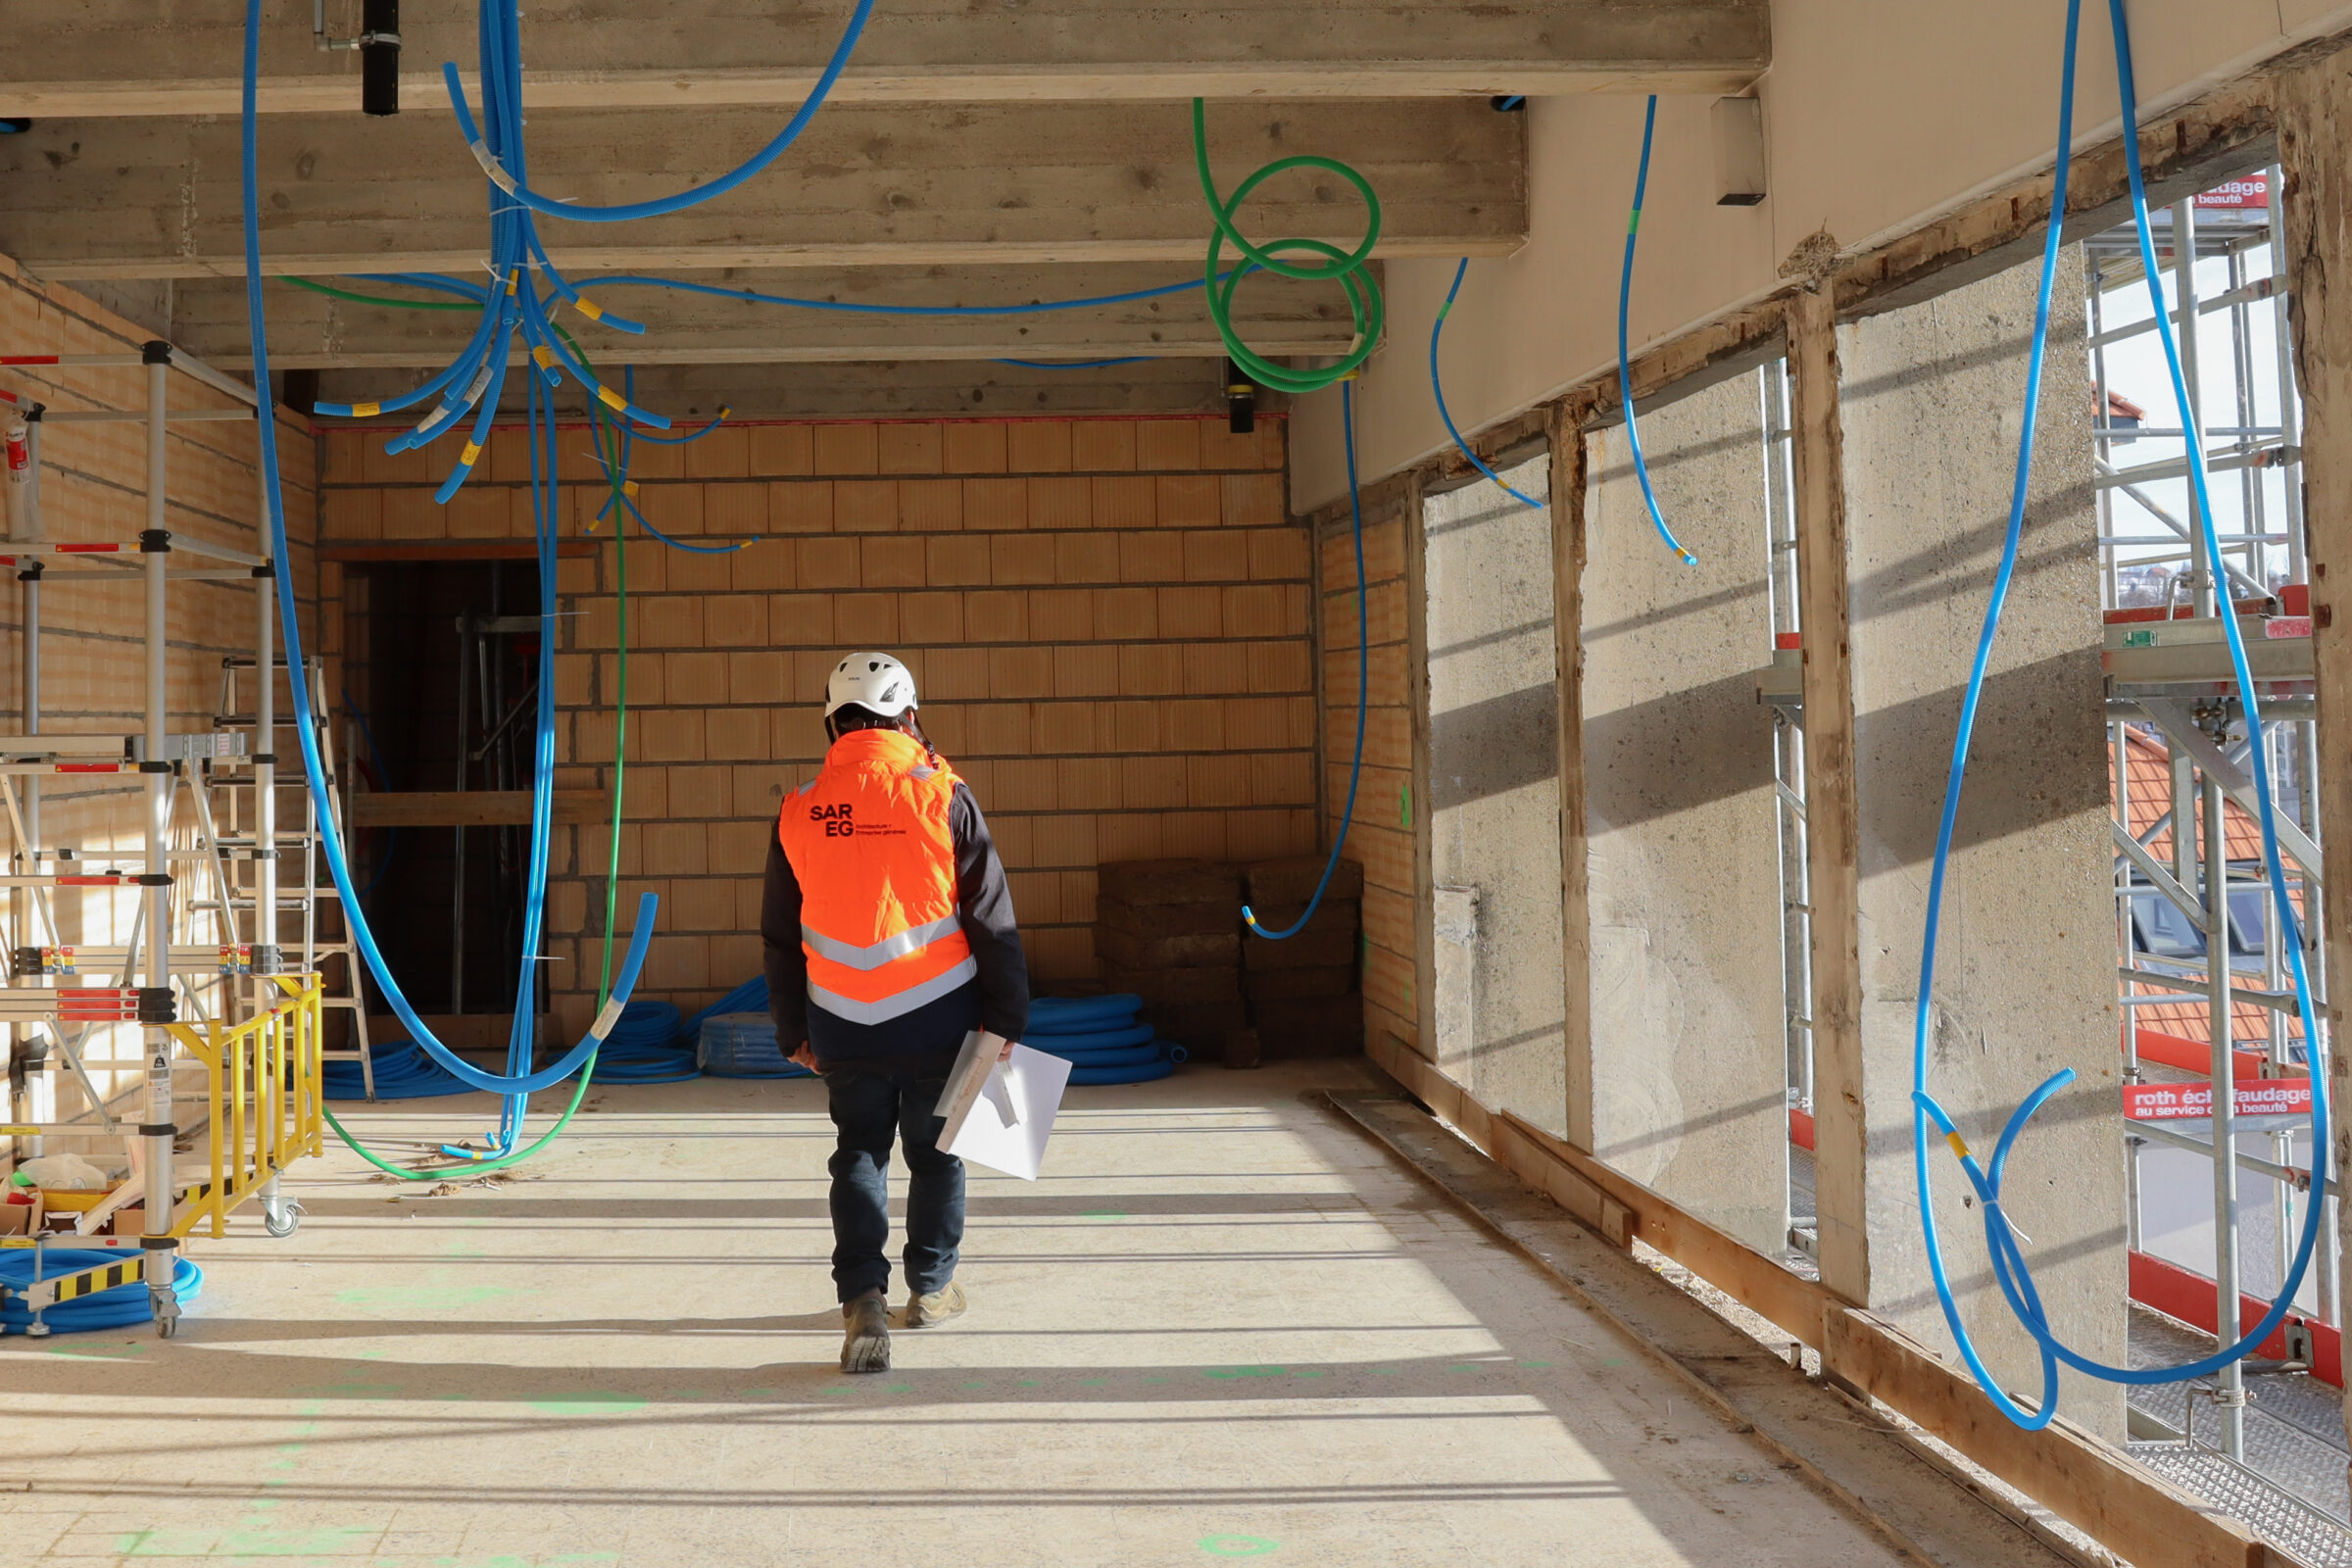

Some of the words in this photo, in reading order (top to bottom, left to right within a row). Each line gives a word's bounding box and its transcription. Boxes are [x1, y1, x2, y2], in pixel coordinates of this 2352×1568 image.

[2198, 194, 2243, 205] beauté
[809, 804, 853, 821] SAR
[826, 820, 854, 837] EG
[2134, 1091, 2177, 1105] roth
[2135, 1107, 2154, 1116] au
[2156, 1105, 2205, 1116] service
[2241, 1102, 2288, 1113] beauté
